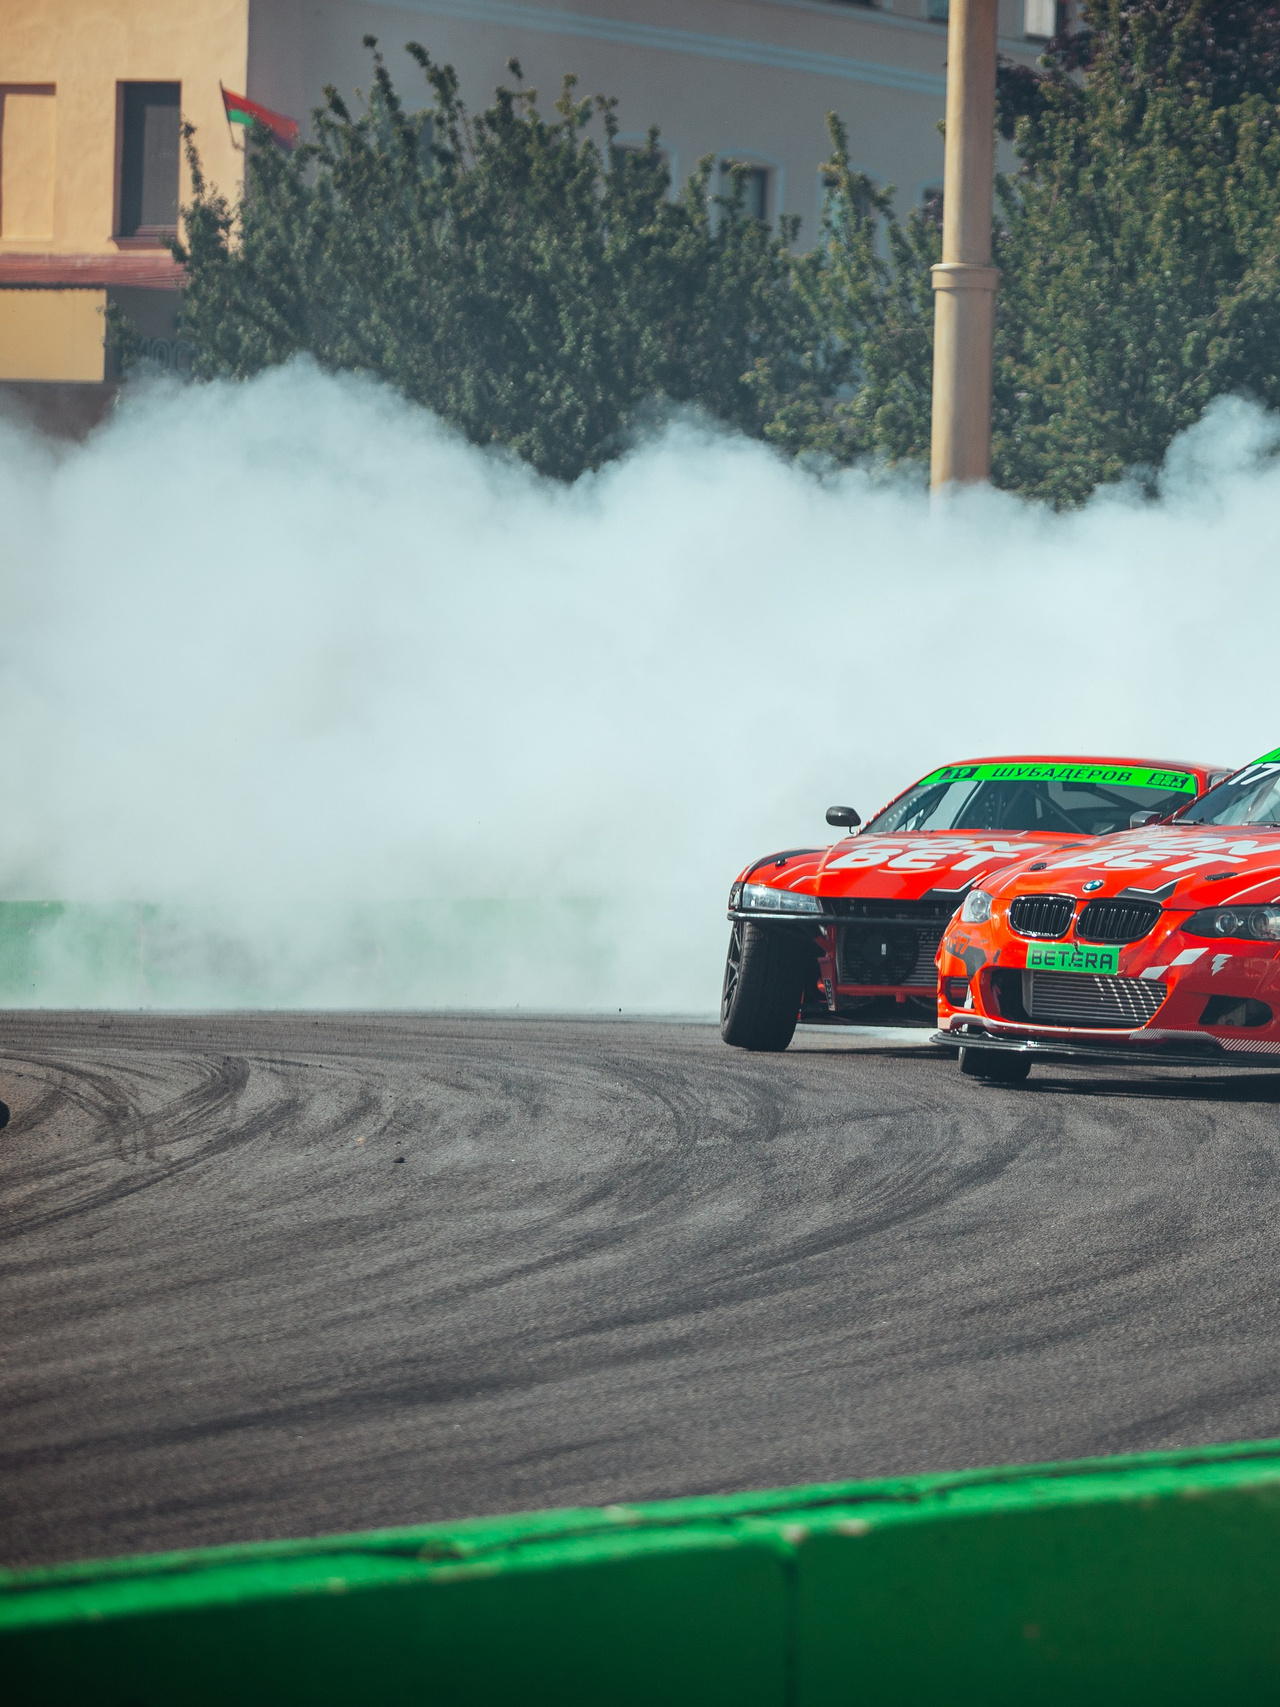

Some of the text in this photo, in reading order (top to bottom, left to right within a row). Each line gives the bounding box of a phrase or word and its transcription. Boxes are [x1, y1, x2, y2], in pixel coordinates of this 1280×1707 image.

[850, 838, 1045, 852] FON
[825, 848, 1021, 871] BET
[1045, 849, 1248, 873] BET
